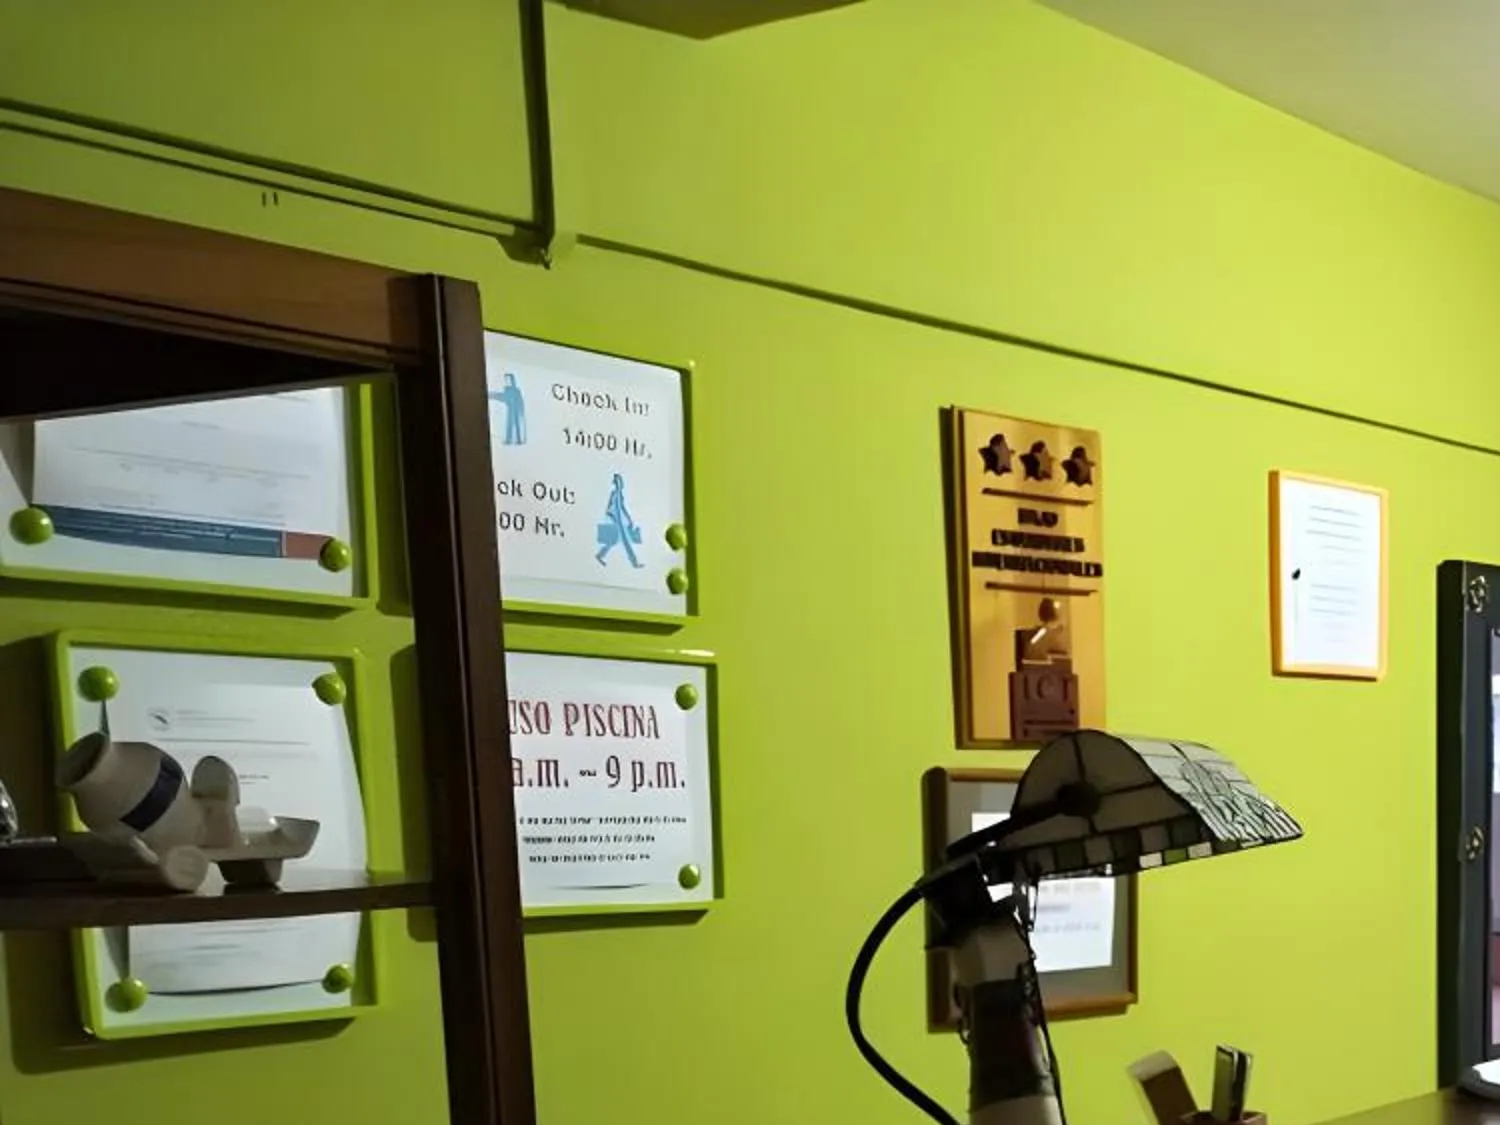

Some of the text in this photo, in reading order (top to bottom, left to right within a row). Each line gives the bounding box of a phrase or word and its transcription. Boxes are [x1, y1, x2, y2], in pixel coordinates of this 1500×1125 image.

[499, 511, 526, 533] 00
[563, 702, 661, 740] PISCINA
[605, 755, 622, 789] 9
[631, 759, 687, 794] p.m.
